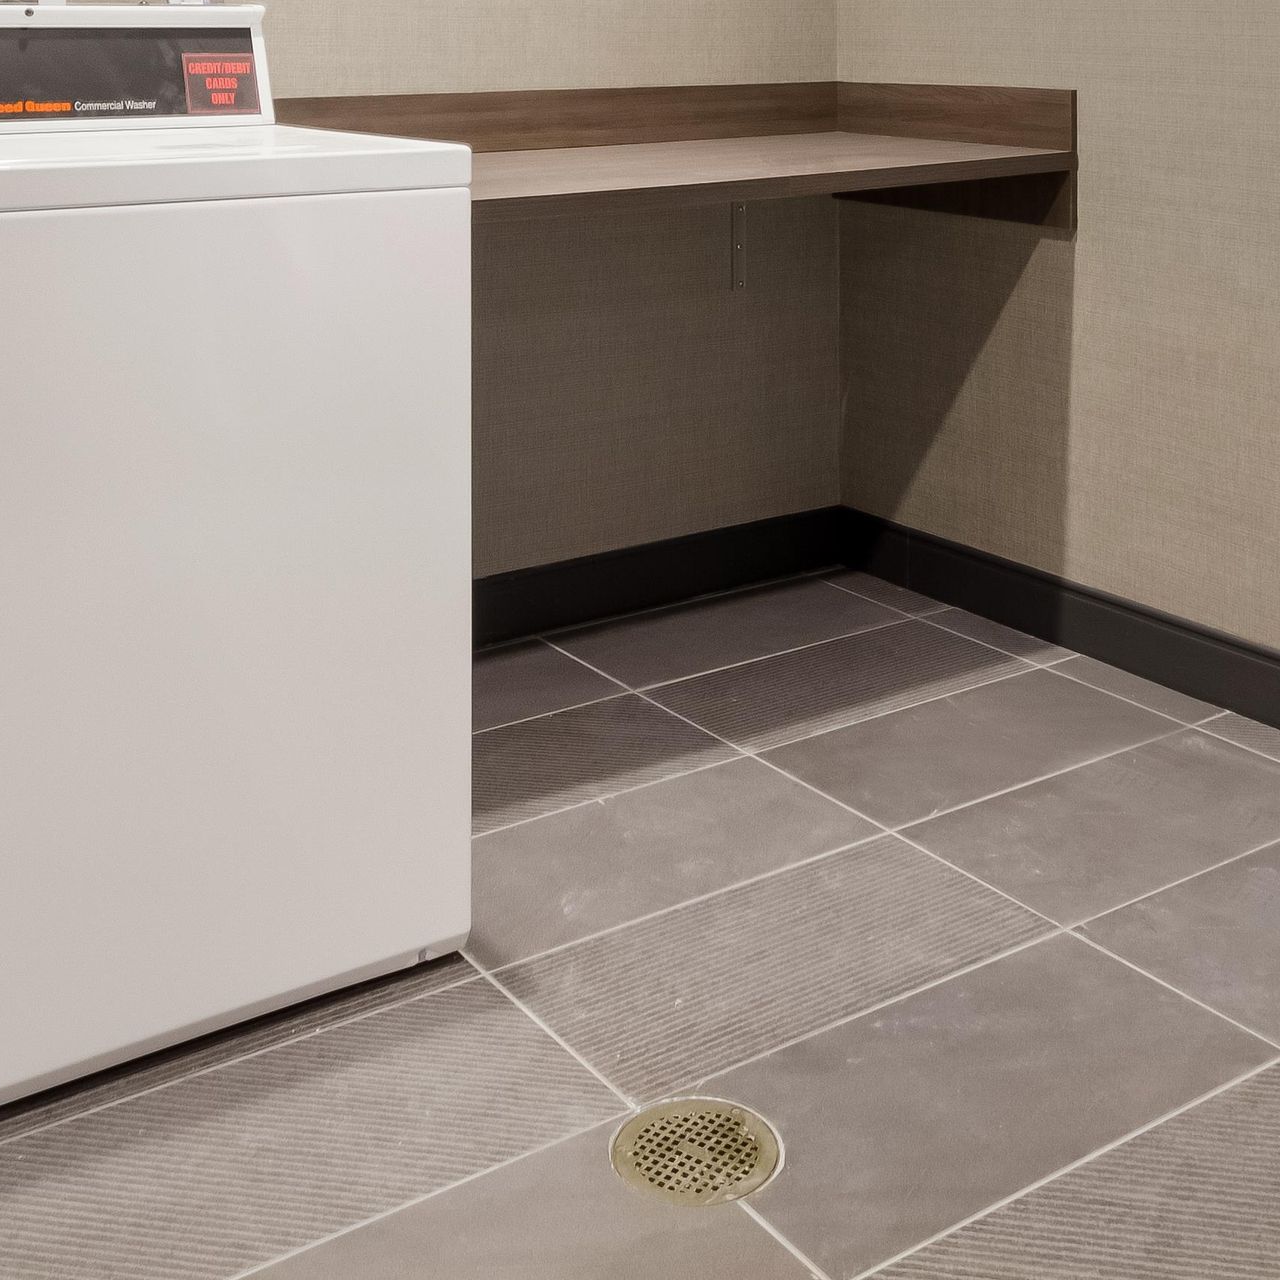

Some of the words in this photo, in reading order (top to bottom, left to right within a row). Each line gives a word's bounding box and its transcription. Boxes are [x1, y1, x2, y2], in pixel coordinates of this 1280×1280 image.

[188, 62, 251, 74] CREDIT/DEBIT
[205, 78, 238, 89] CARDS
[211, 92, 236, 105] ONLY
[25, 100, 71, 113] Queen
[74, 100, 123, 111] Commercial
[125, 100, 156, 111] Washer
